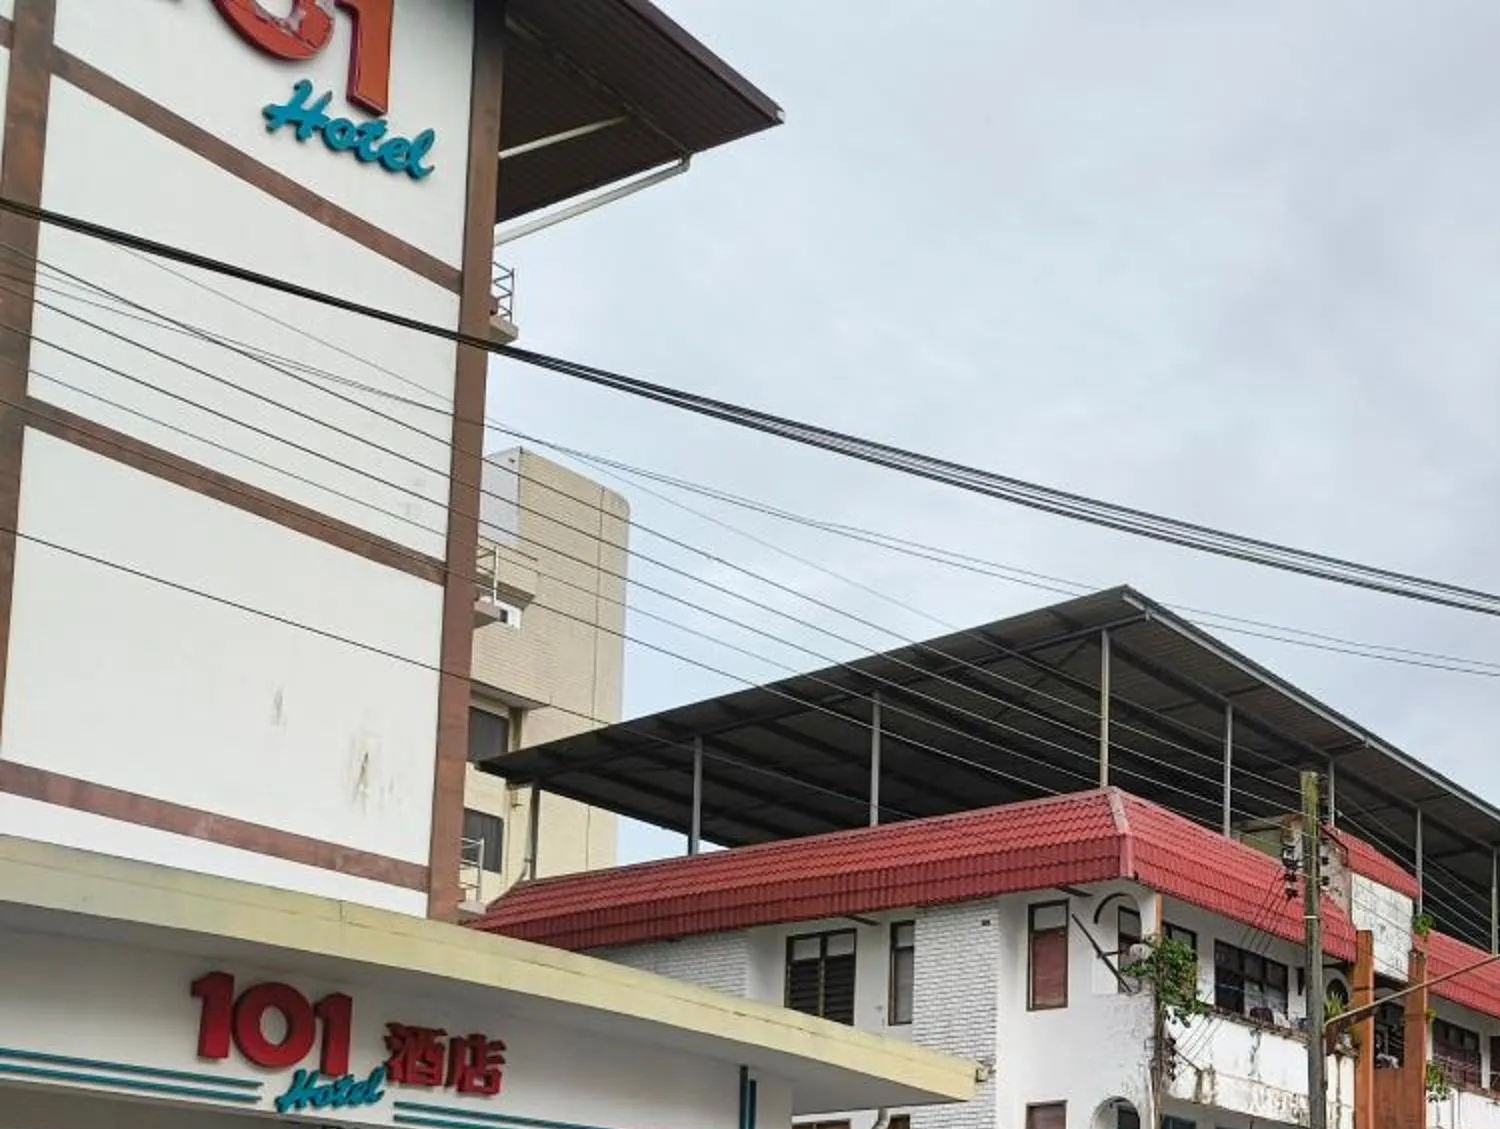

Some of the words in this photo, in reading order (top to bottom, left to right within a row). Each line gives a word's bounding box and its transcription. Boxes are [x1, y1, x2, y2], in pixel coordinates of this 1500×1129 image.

[262, 79, 435, 181] Hotel
[191, 970, 353, 1077] 101
[383, 1022, 506, 1095] 酒店
[274, 1063, 386, 1113] Hotel
